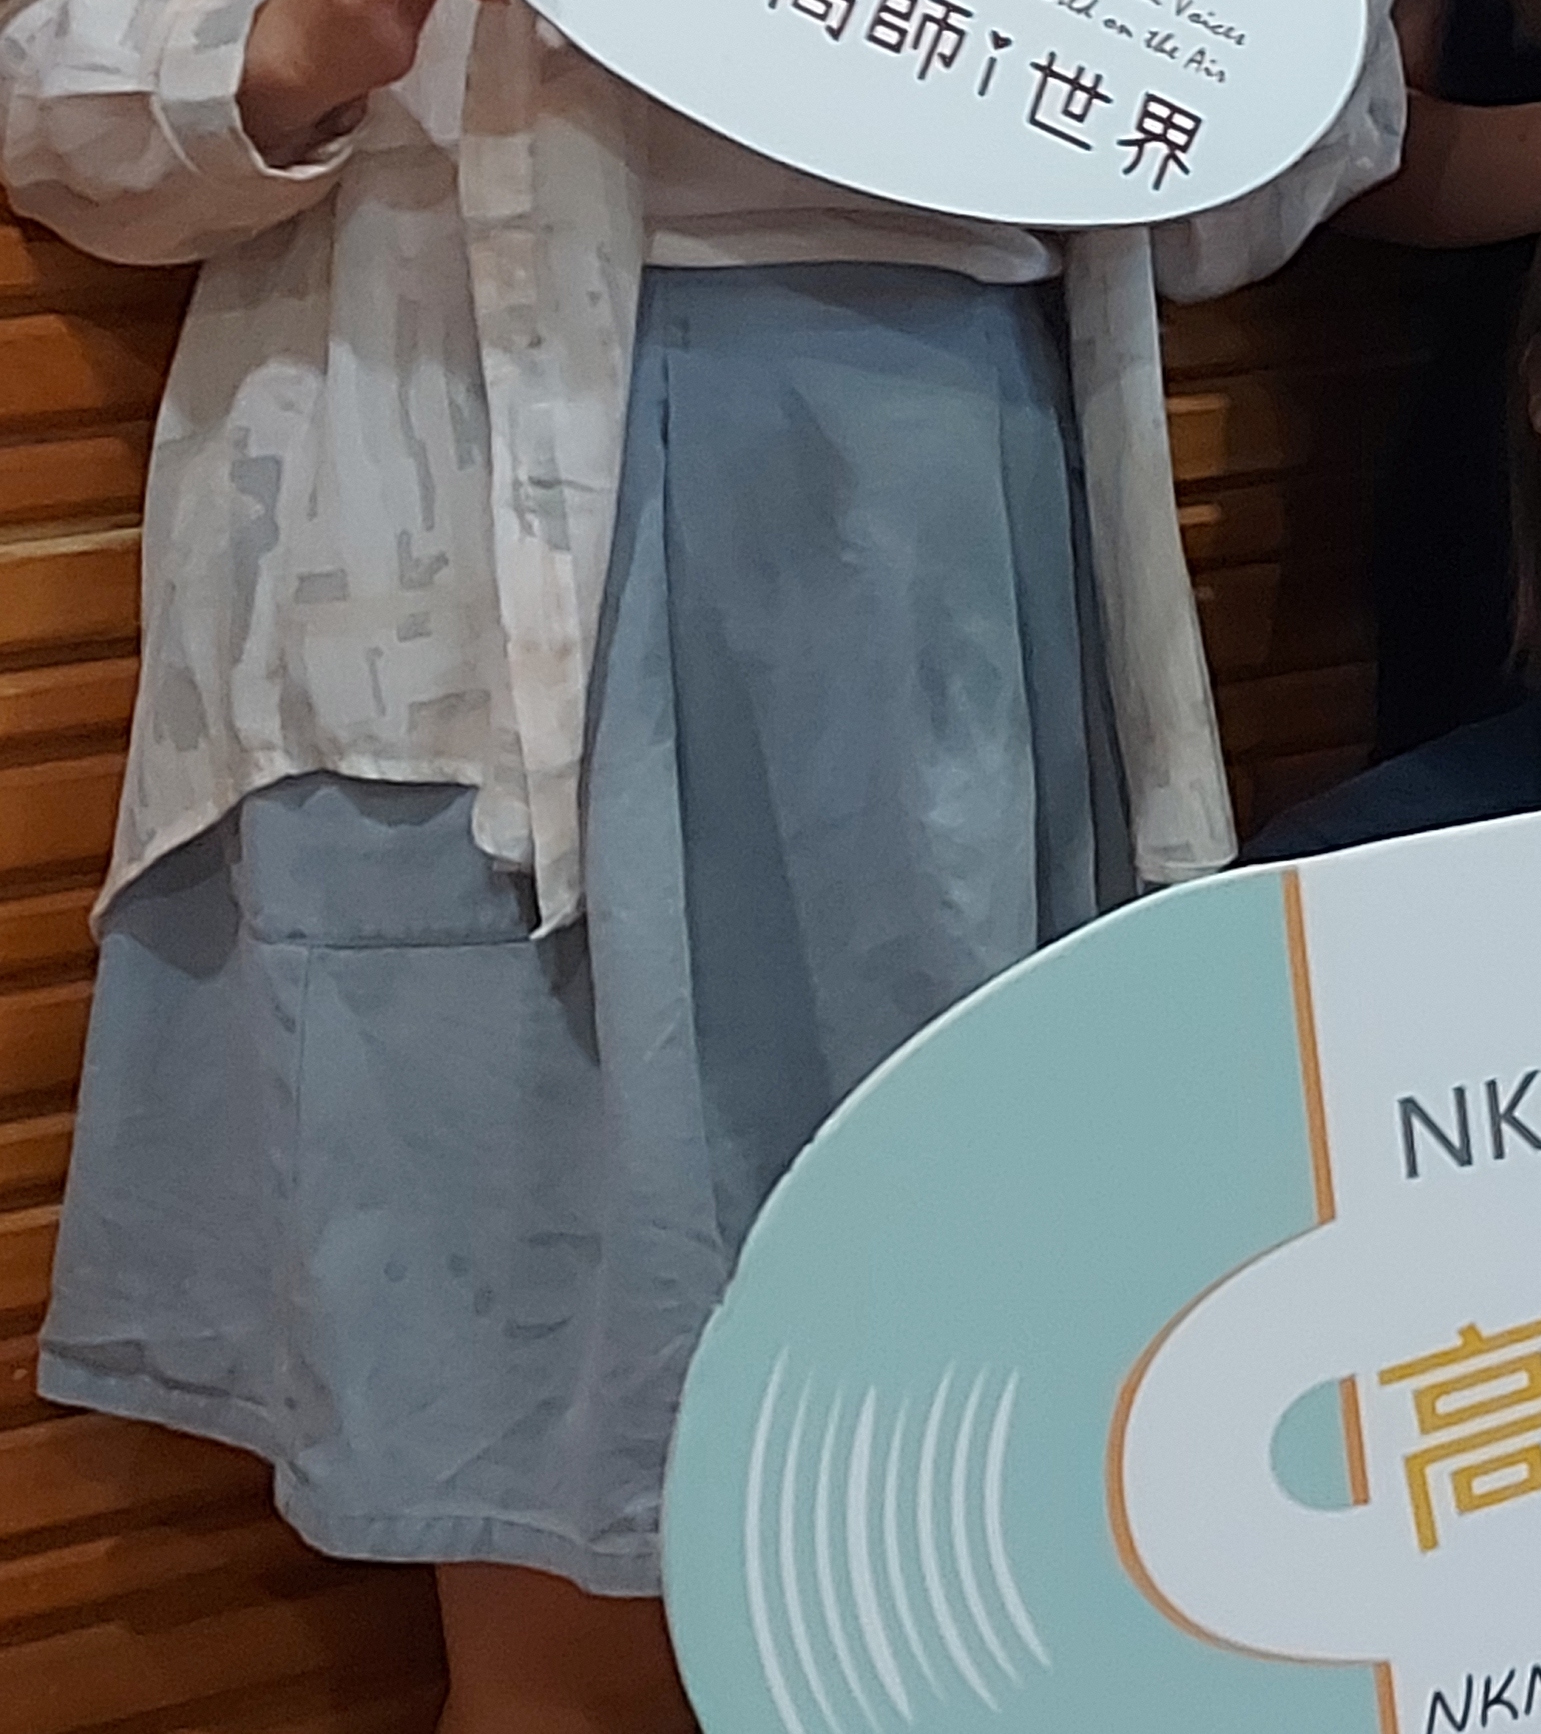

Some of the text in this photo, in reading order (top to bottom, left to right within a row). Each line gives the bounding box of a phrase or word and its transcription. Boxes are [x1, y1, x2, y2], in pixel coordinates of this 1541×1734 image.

[1102, 16, 1135, 40] on
[1144, 25, 1181, 61] the
[1182, 46, 1227, 83] Air
